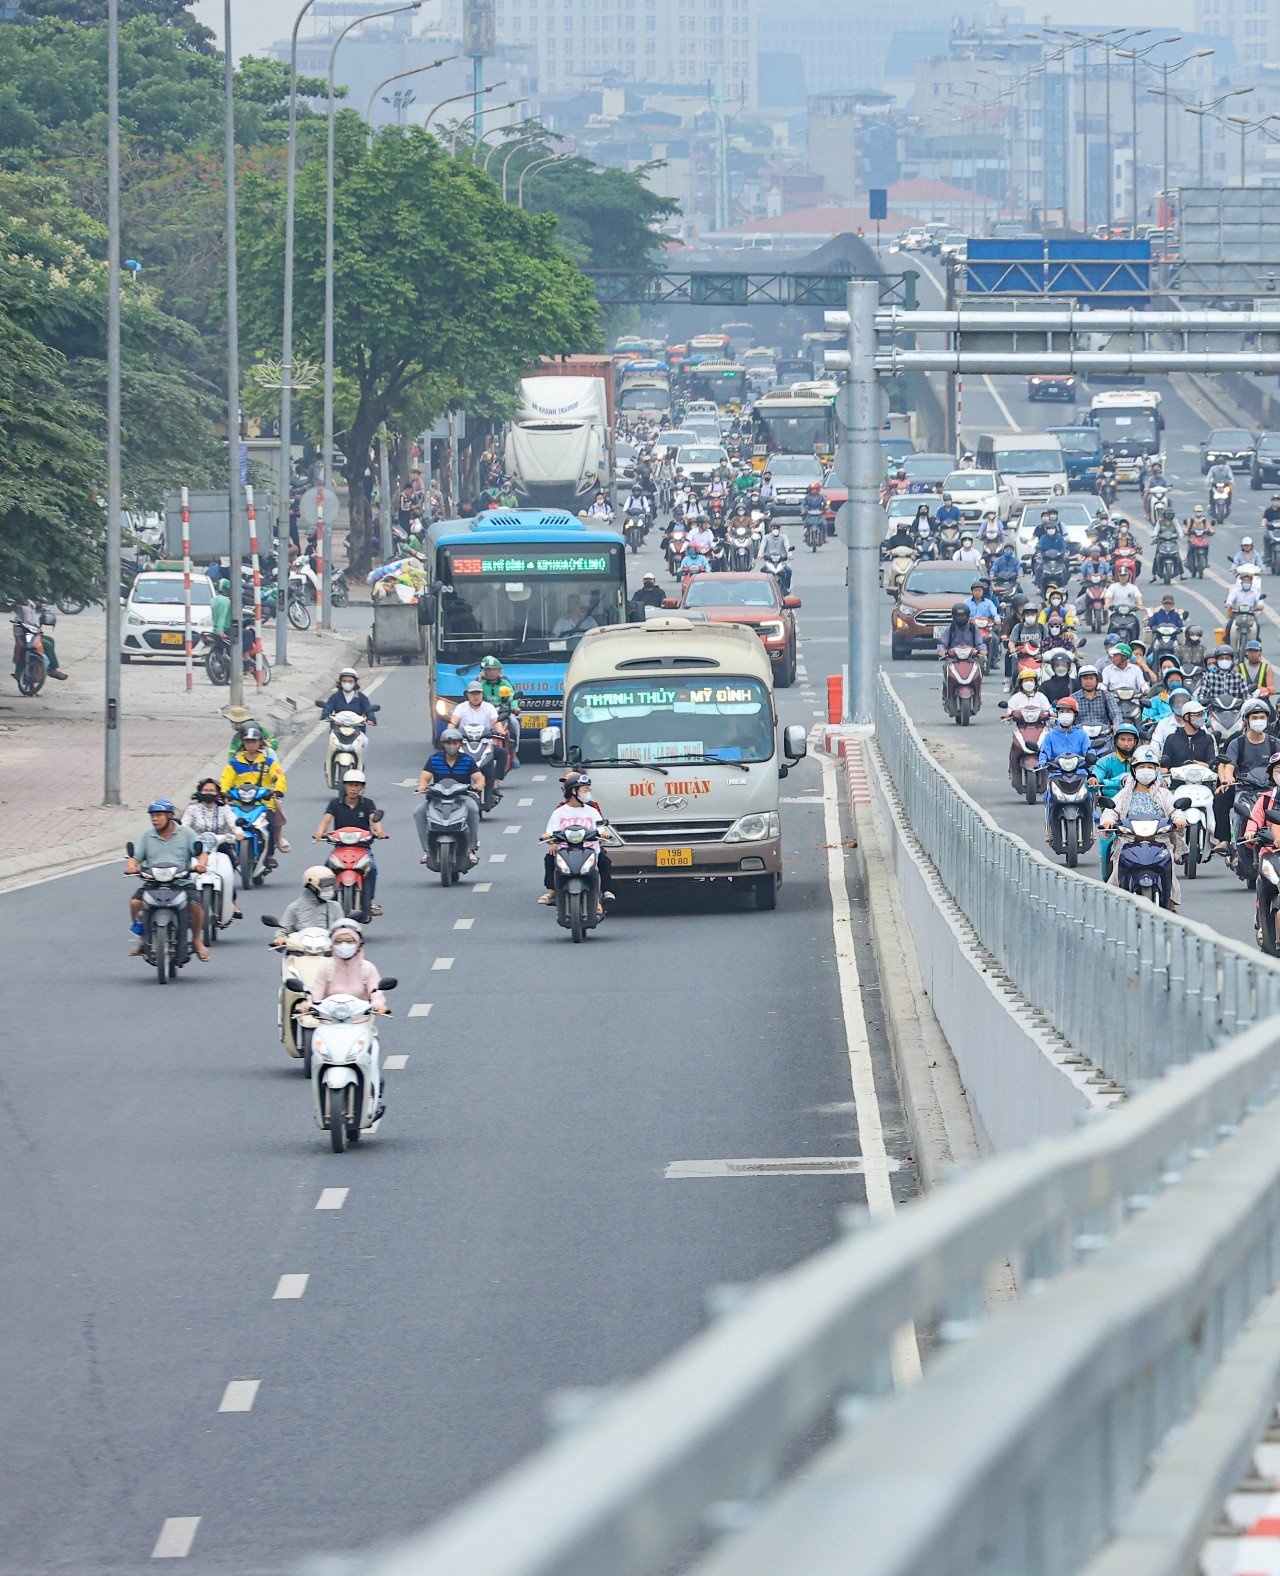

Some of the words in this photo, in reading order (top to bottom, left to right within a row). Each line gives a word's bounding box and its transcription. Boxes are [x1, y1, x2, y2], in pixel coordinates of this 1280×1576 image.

[583, 693, 634, 707] THANH
[690, 687, 713, 703] MỸ
[715, 685, 752, 702] ĐÌNH
[519, 700, 564, 708] ANOIBUS
[629, 778, 655, 797] ĐỨC
[664, 776, 711, 799] THUẬN
[667, 849, 682, 857] 19B
[660, 857, 688, 865] 010.80
